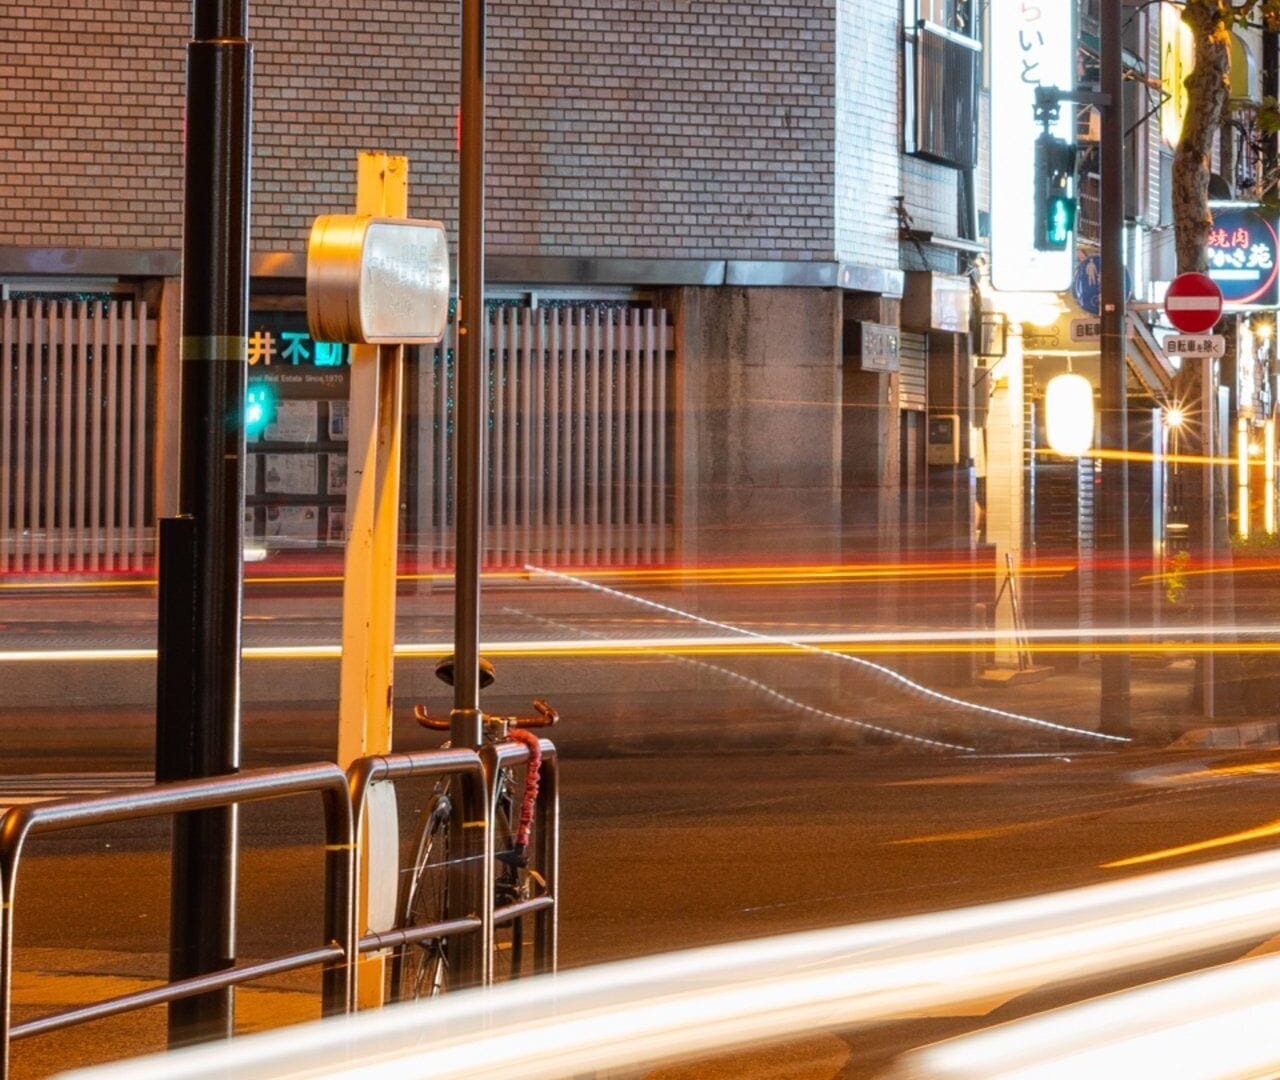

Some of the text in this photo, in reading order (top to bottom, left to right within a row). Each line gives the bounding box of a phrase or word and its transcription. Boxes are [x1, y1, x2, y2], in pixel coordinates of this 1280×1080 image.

[1168, 340, 1218, 353] 自転車を除く
